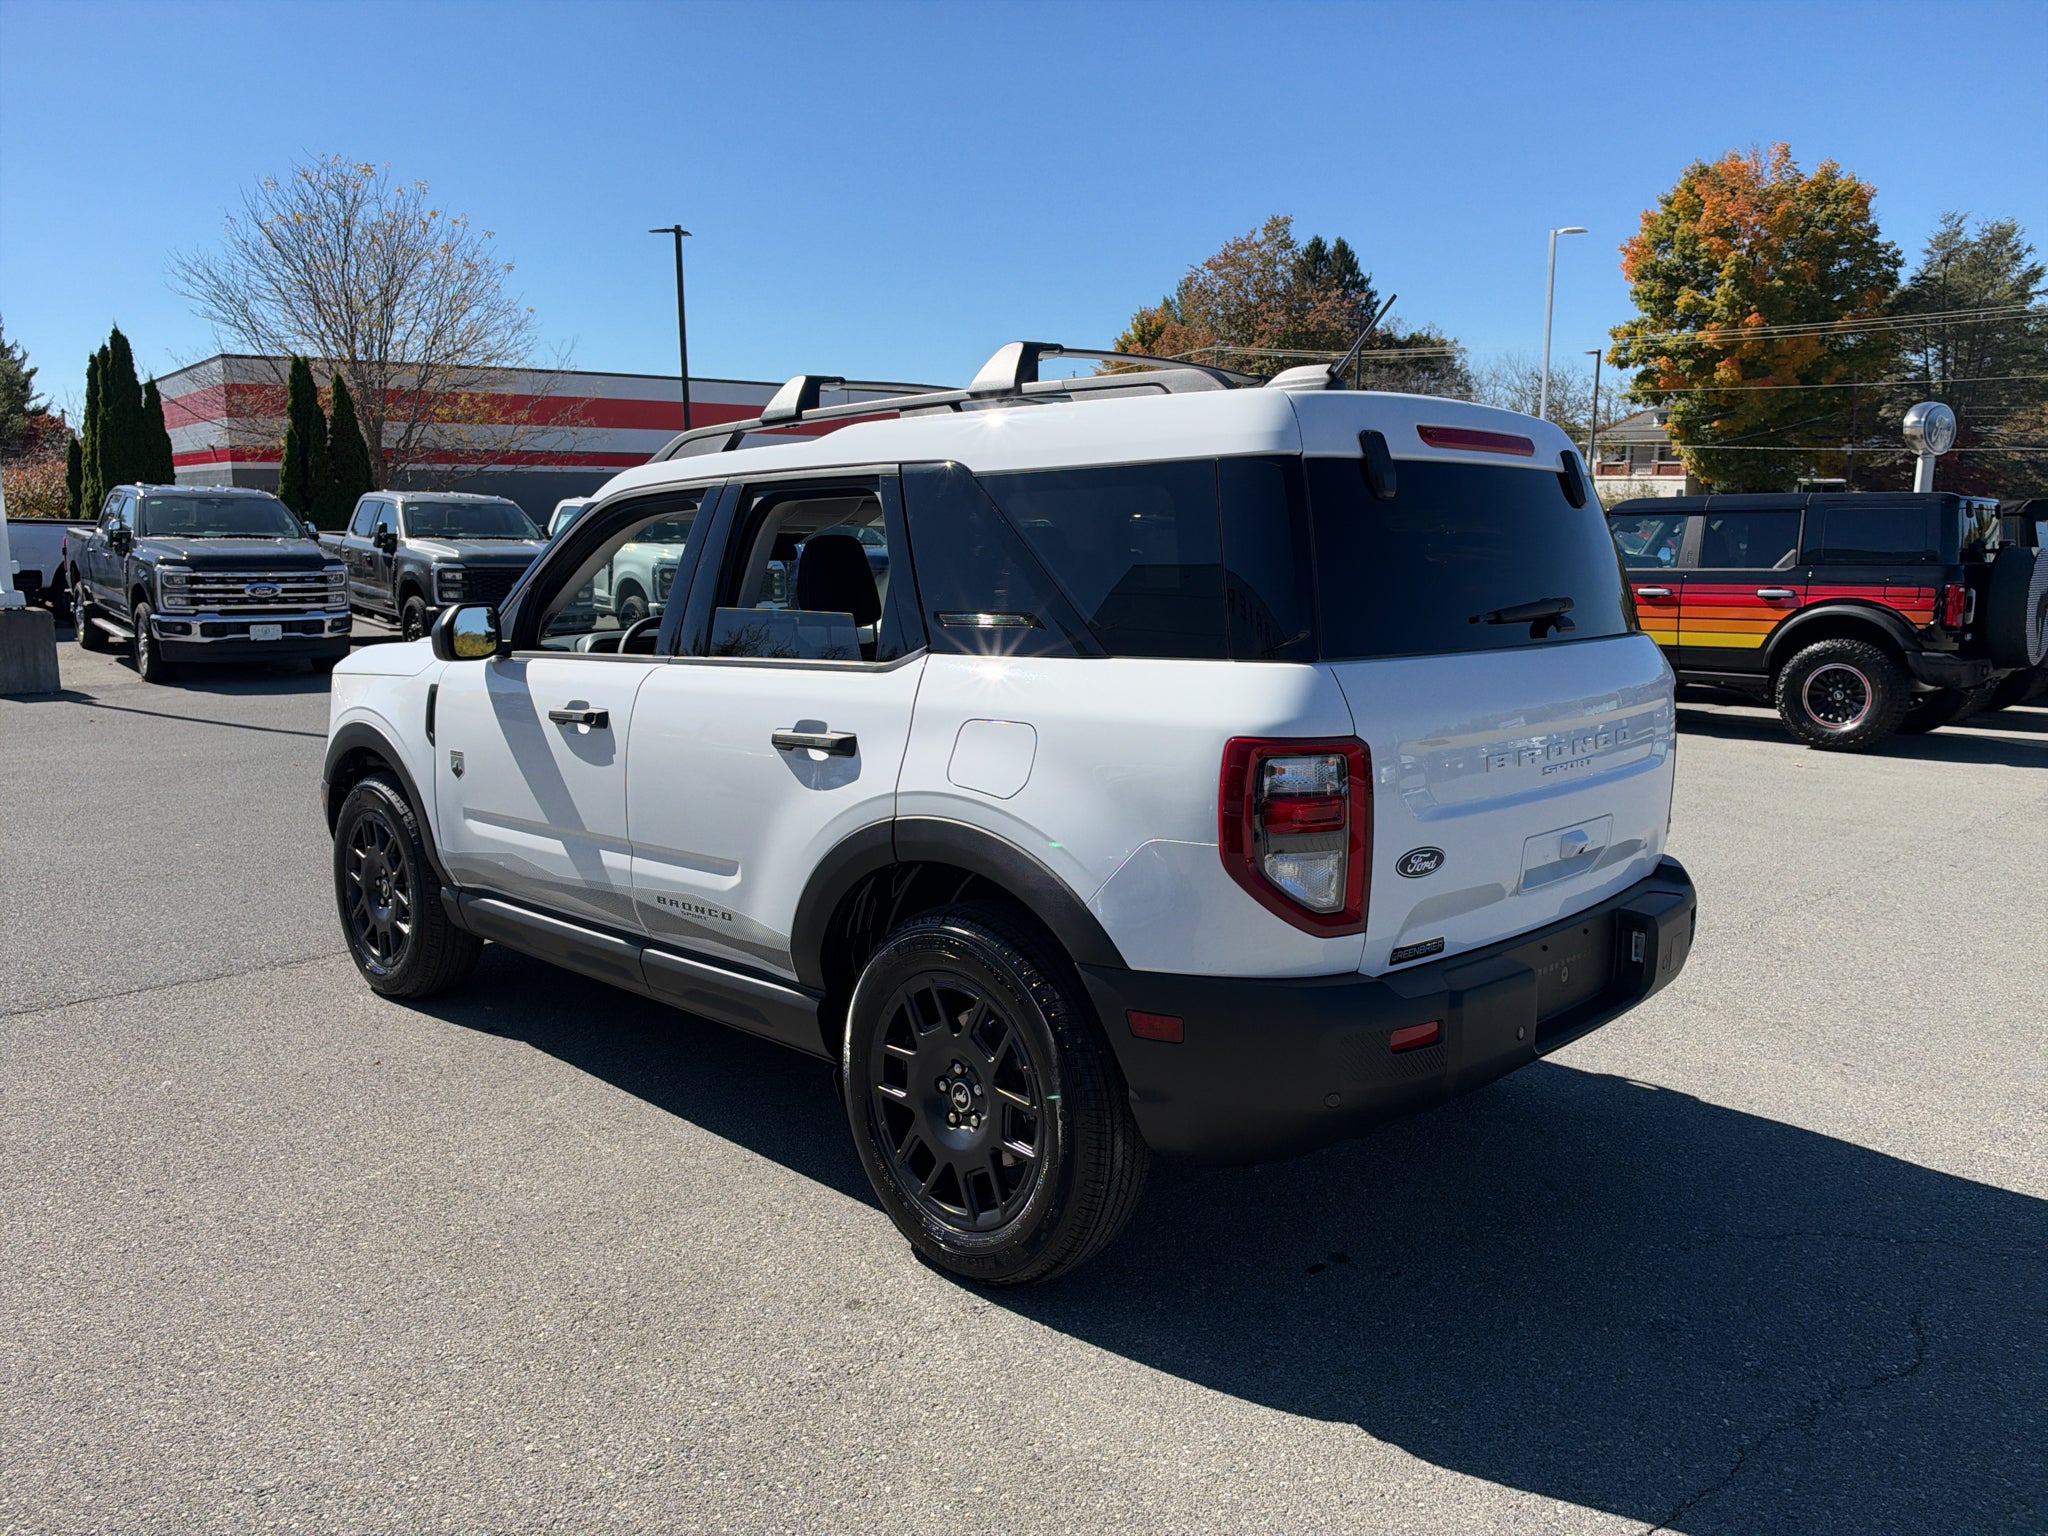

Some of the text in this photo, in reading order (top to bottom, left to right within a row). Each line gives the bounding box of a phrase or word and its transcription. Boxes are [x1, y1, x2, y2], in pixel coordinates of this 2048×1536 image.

[1486, 726, 1630, 773] BRONCO
[1542, 755, 1595, 775] SPORT
[1406, 852, 1438, 873] Ford
[656, 895, 733, 922] BRONCO
[680, 910, 710, 921] SPORT
[1391, 939, 1444, 962] GREENBRIER
